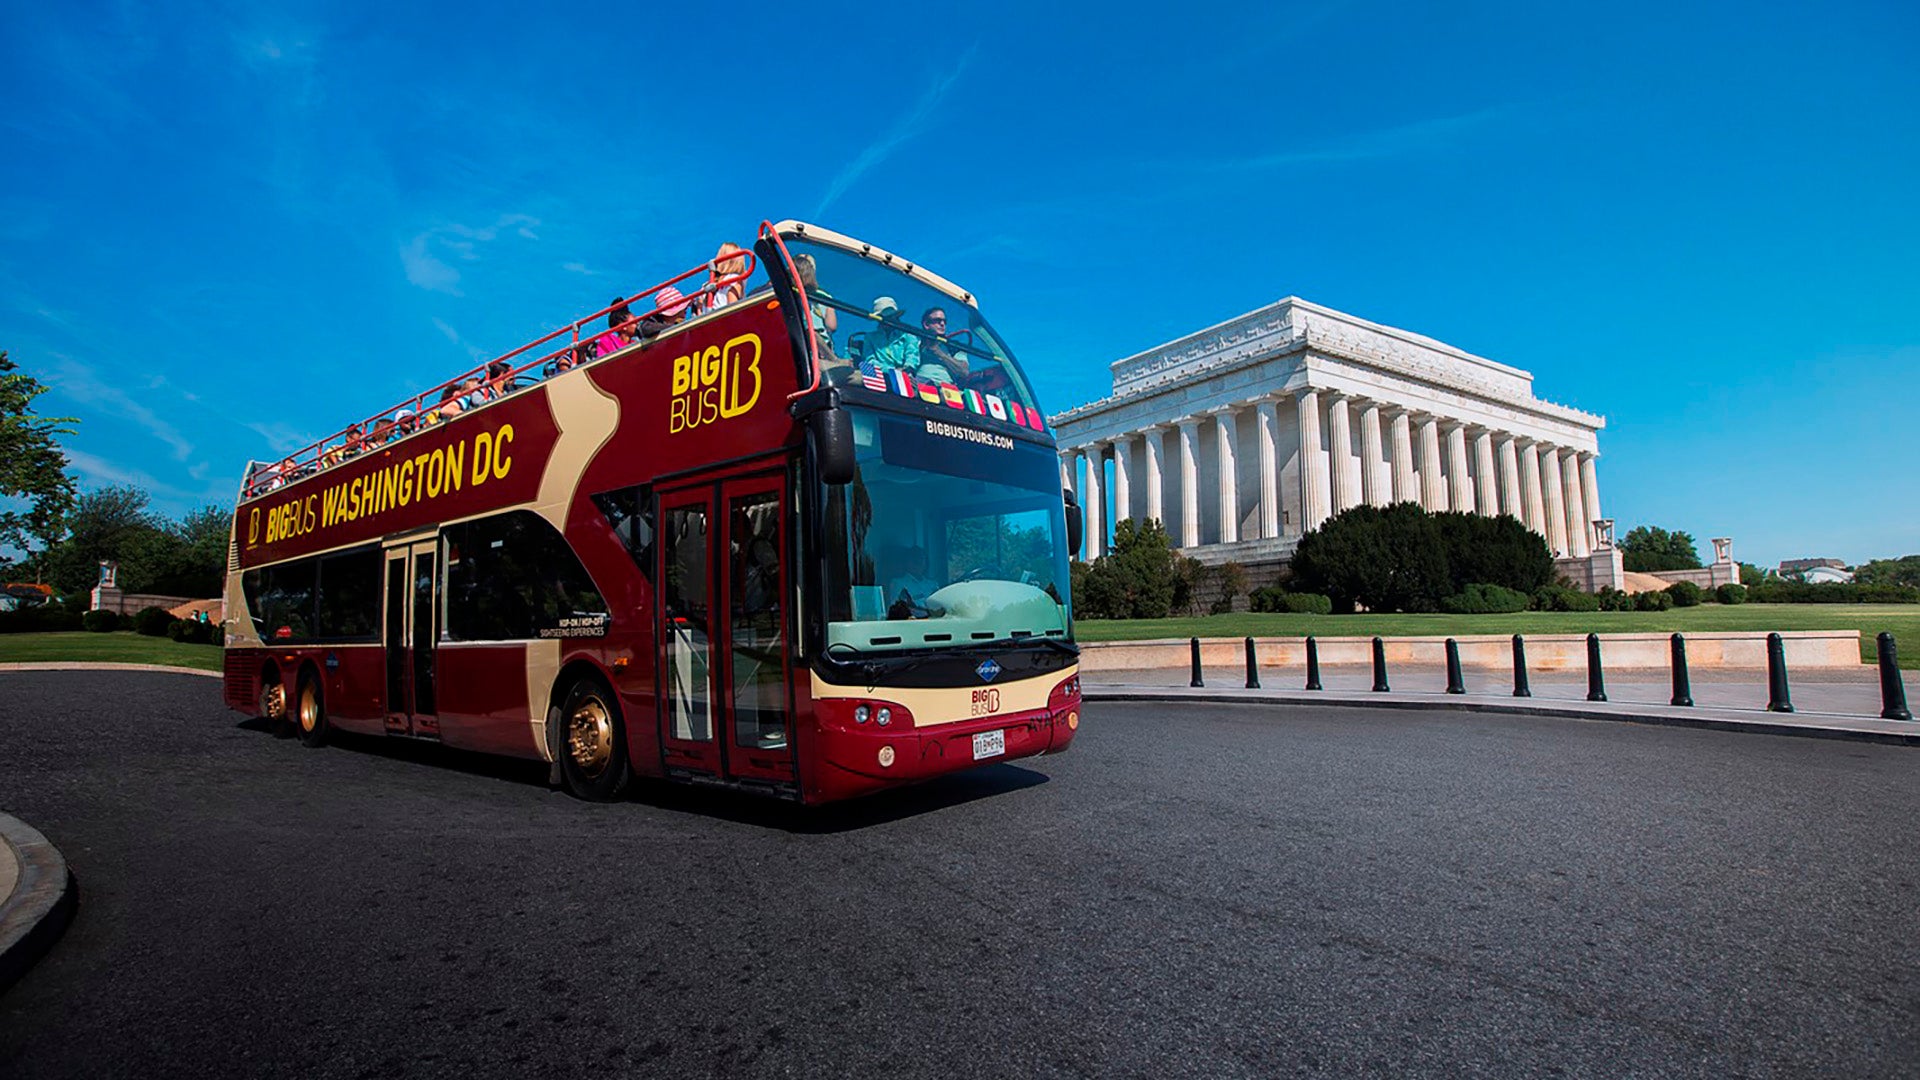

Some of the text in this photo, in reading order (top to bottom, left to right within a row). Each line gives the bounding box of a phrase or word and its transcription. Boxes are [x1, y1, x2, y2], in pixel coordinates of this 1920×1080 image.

[672, 345, 720, 396] BIG
[670, 387, 718, 433] BUS
[926, 420, 1014, 450] BIGBUSTOURS.COM
[322, 440, 465, 528] WASHINGTON
[472, 424, 514, 486] DC
[972, 690, 987, 703] BIG
[972, 703, 987, 716] BUS
